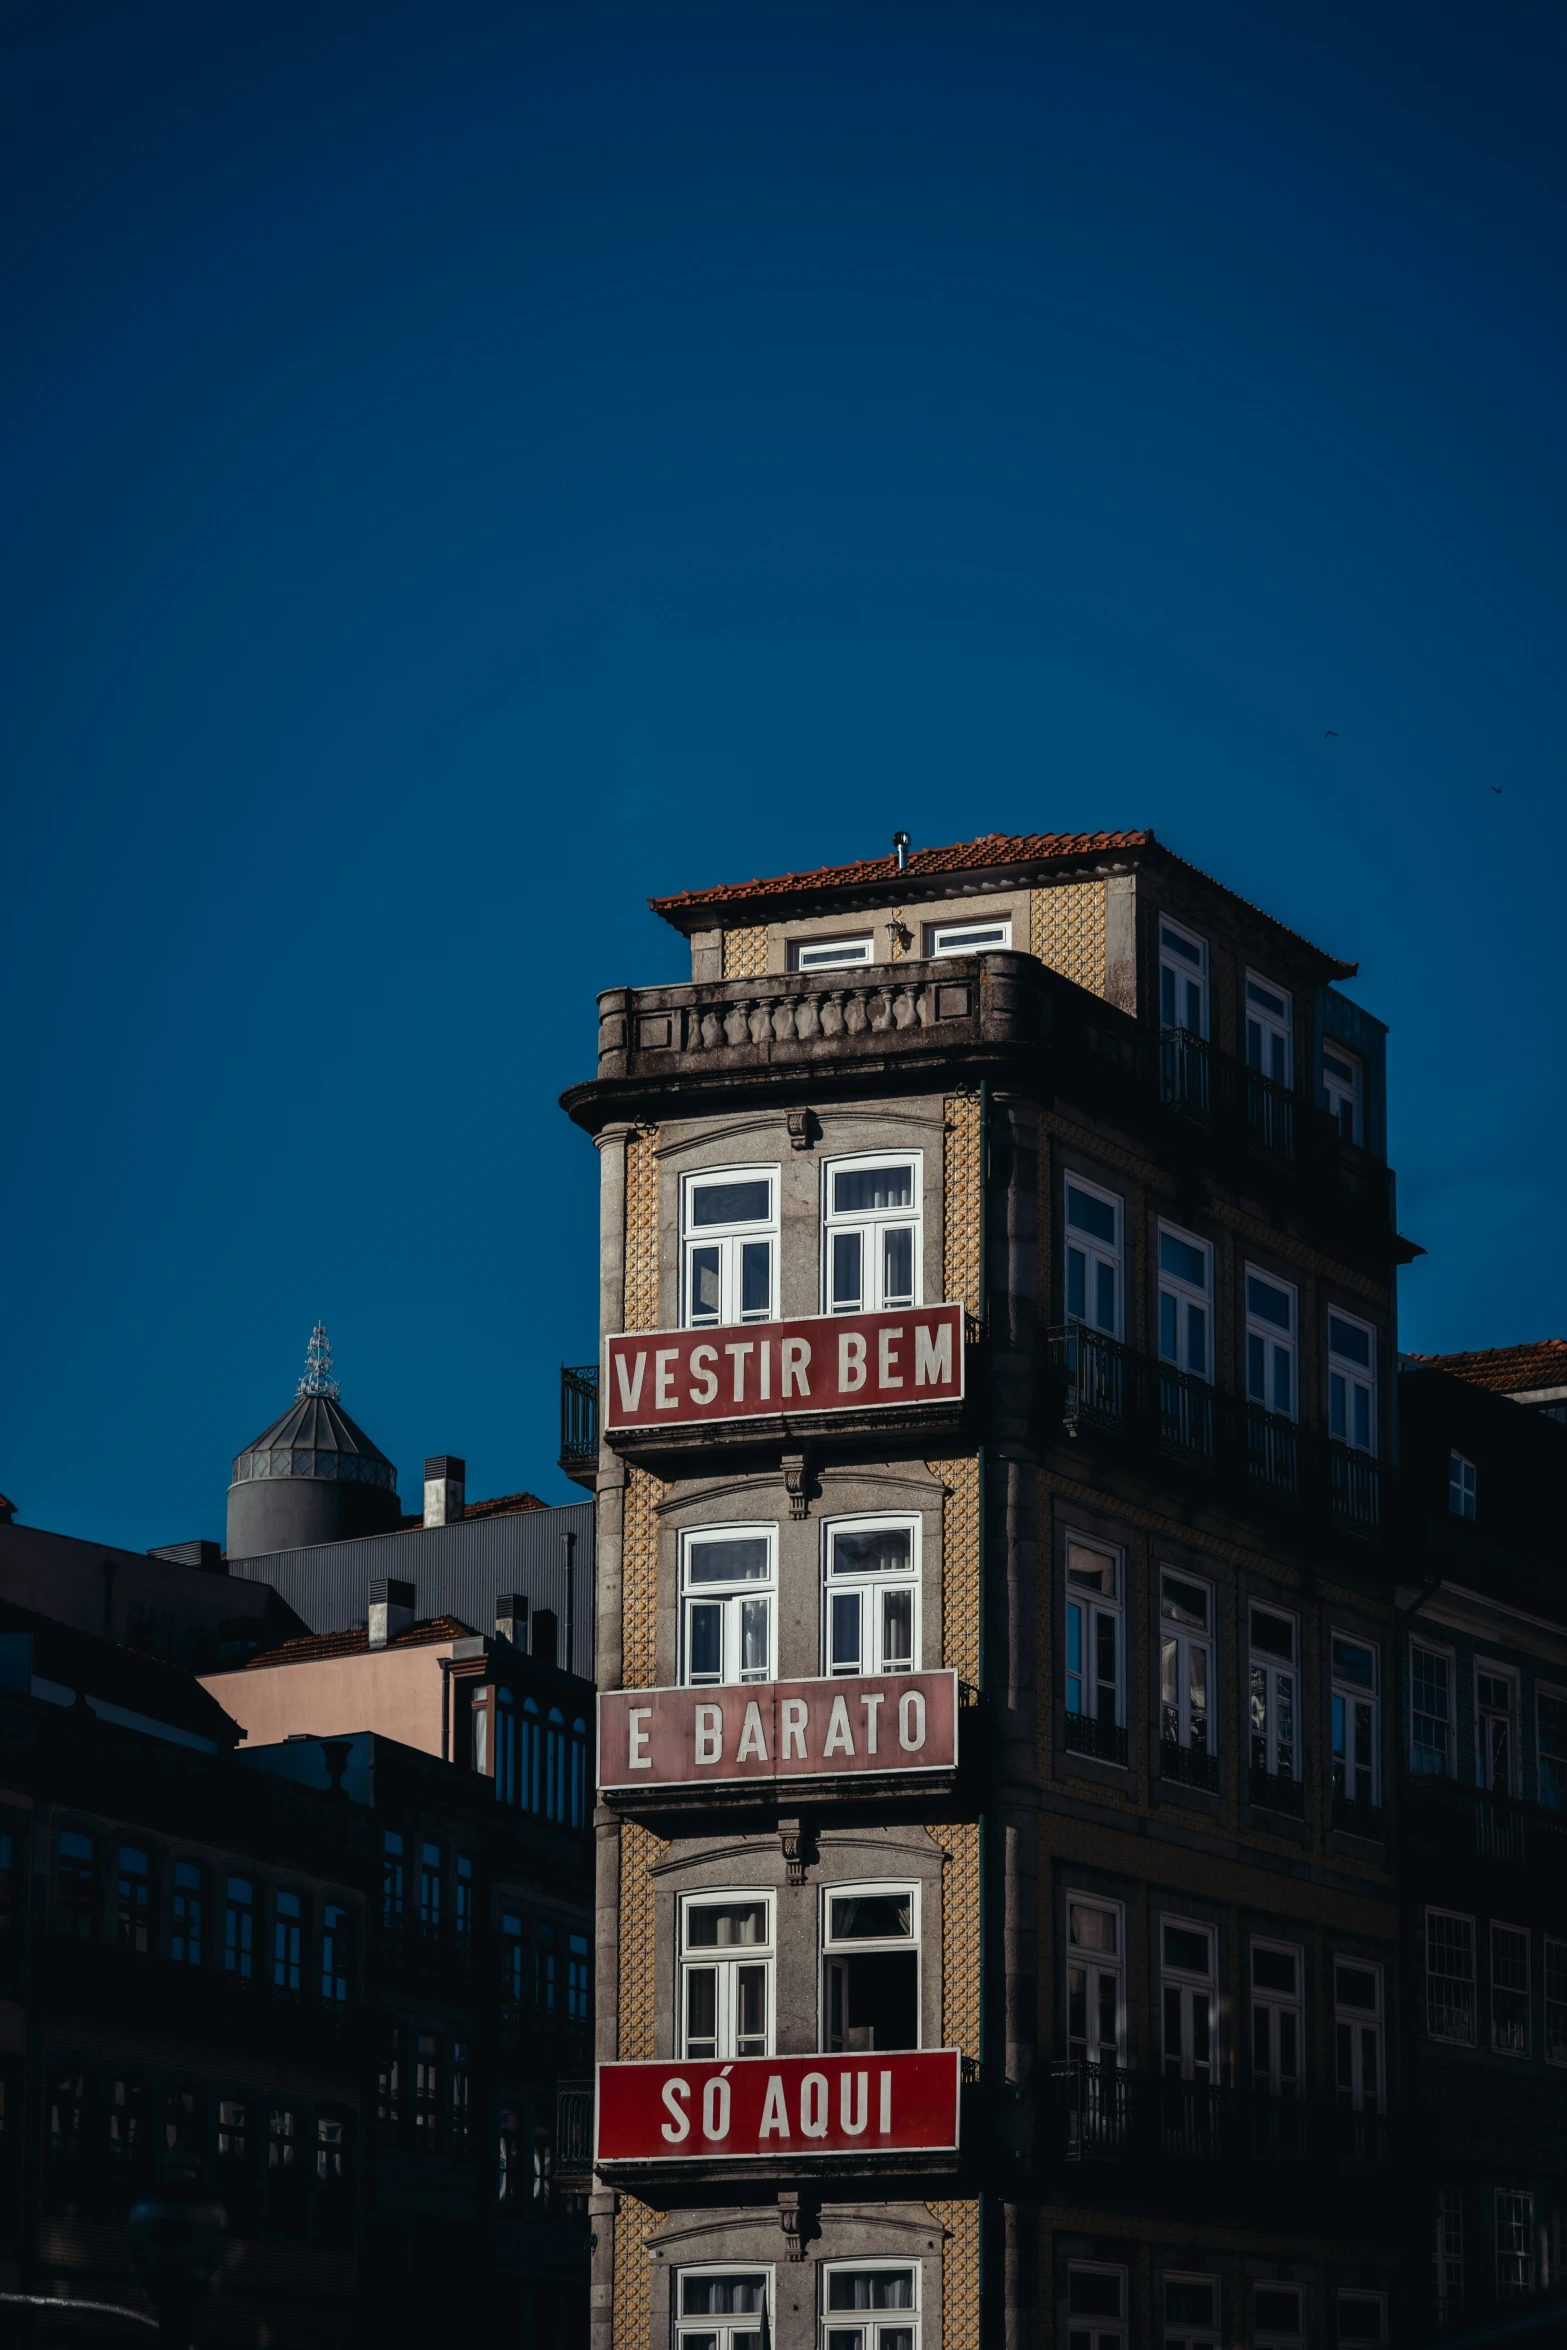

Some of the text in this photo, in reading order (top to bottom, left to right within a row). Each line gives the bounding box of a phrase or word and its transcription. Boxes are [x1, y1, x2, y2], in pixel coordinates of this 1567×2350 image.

[614, 1322, 953, 1412] VESTIR BEM
[628, 1690, 926, 1769] E BARATO
[660, 2065, 892, 2143] SÓ AQUI
